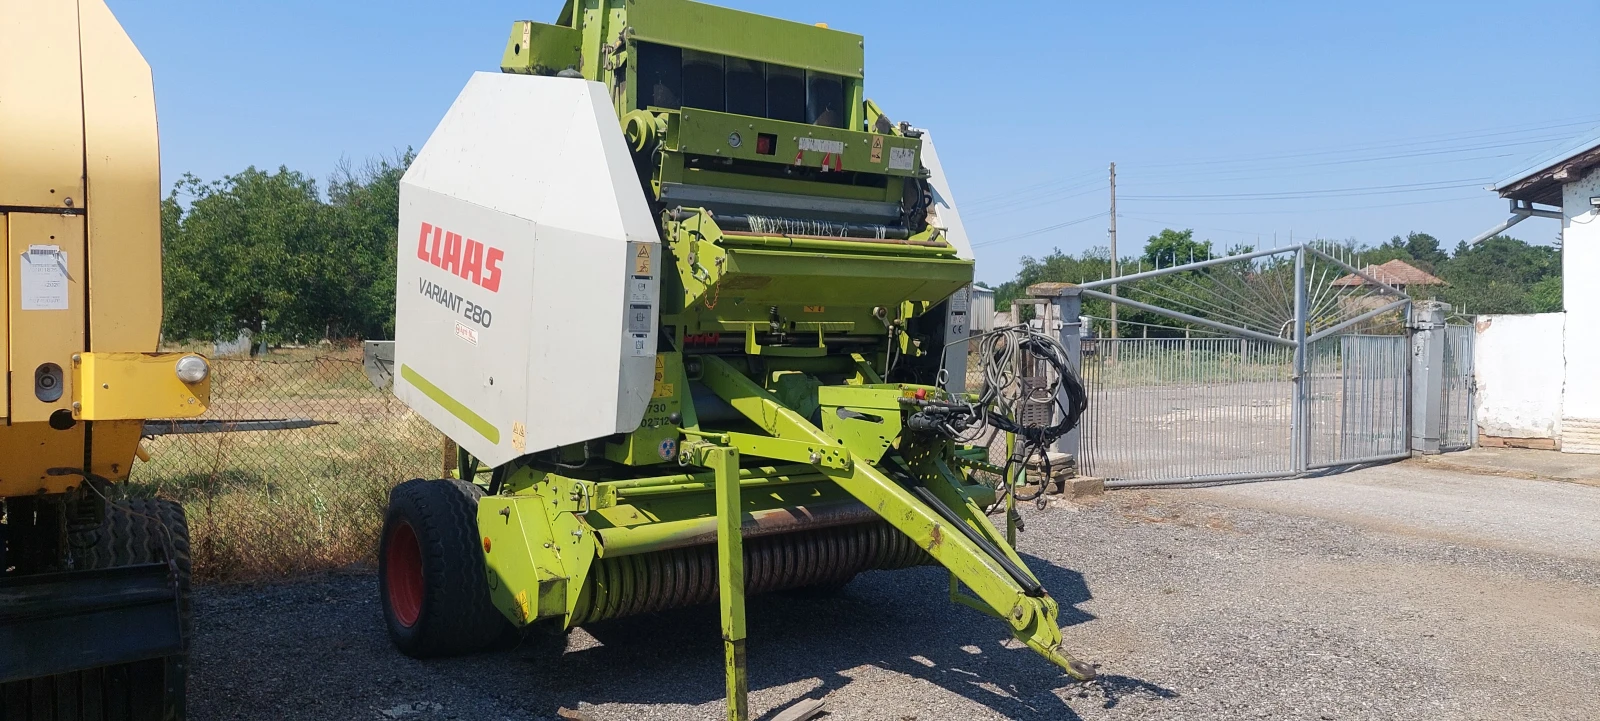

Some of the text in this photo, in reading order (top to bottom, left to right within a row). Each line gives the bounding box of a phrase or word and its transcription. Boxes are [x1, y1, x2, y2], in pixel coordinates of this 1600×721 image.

[417, 221, 504, 293] CLAAS
[418, 276, 492, 329] VARIANT 280
